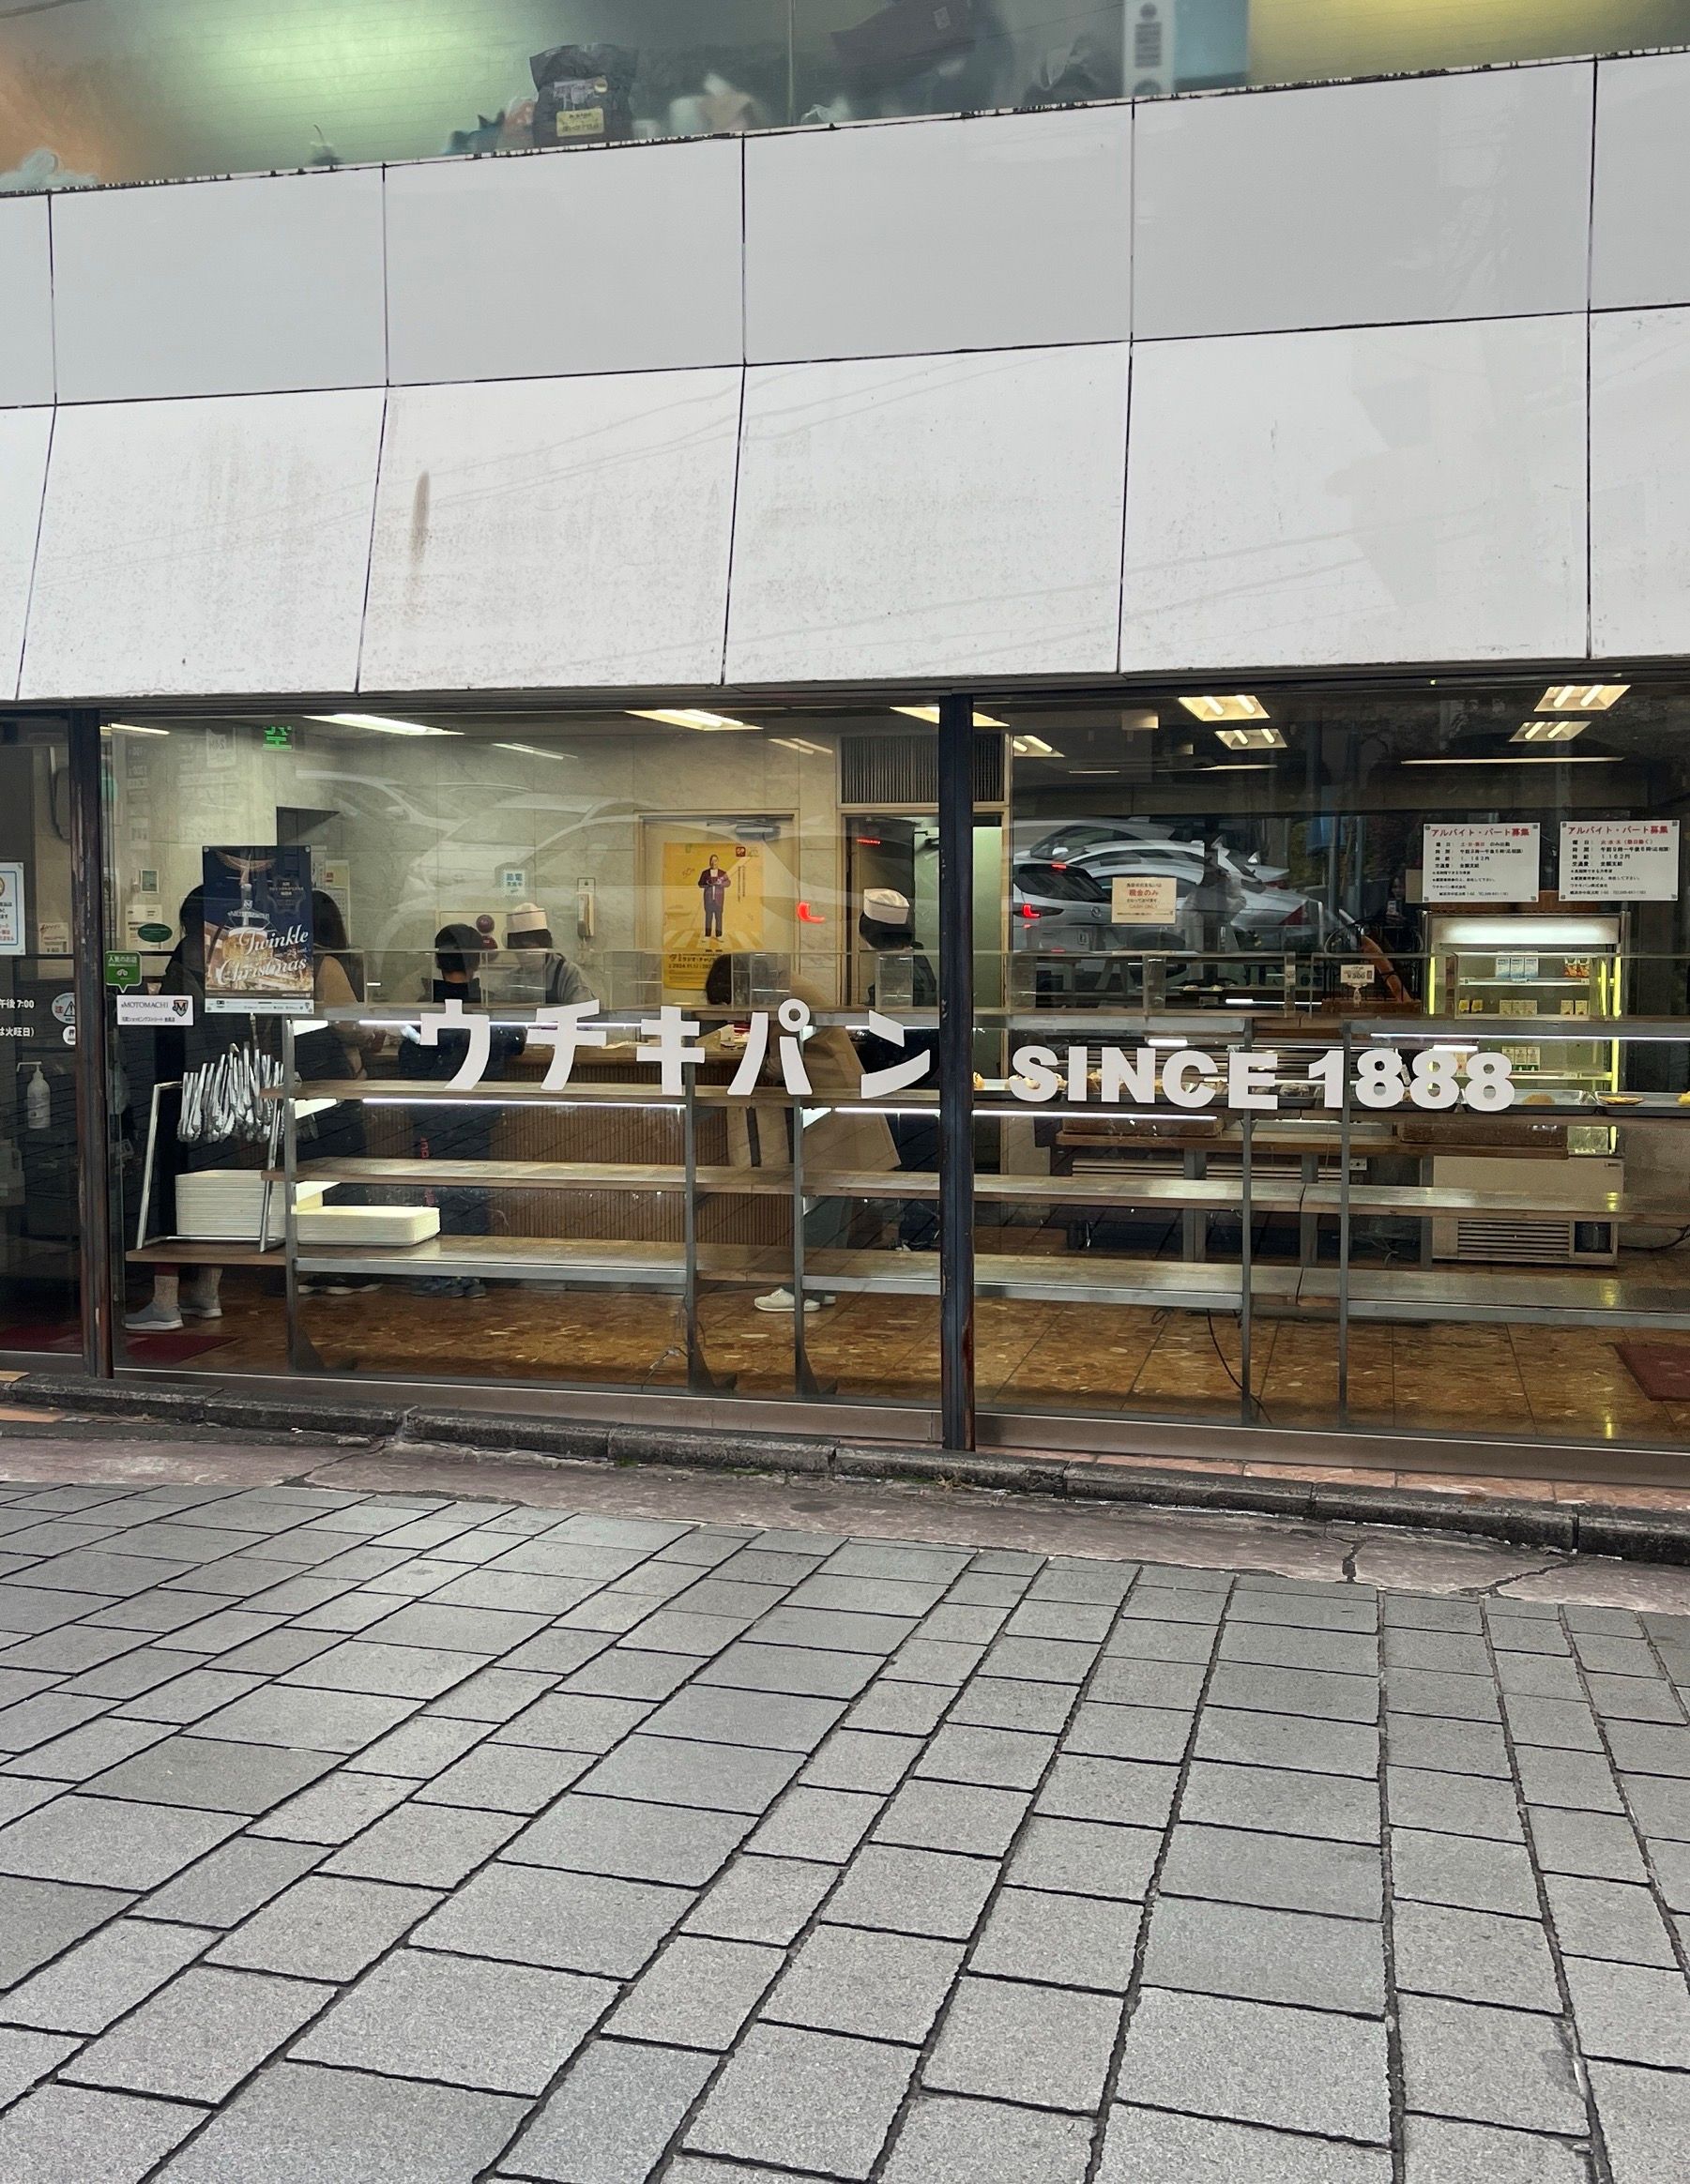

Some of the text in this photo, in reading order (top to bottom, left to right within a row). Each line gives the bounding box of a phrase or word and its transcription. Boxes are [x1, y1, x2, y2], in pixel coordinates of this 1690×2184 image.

[239, 923, 309, 956] Twinkle
[217, 958, 307, 986] Christmas
[17, 999, 35, 1009] 7:00
[419, 998, 931, 1100] ウチキパン
[1010, 1044, 1515, 1112] SINCE 1888
